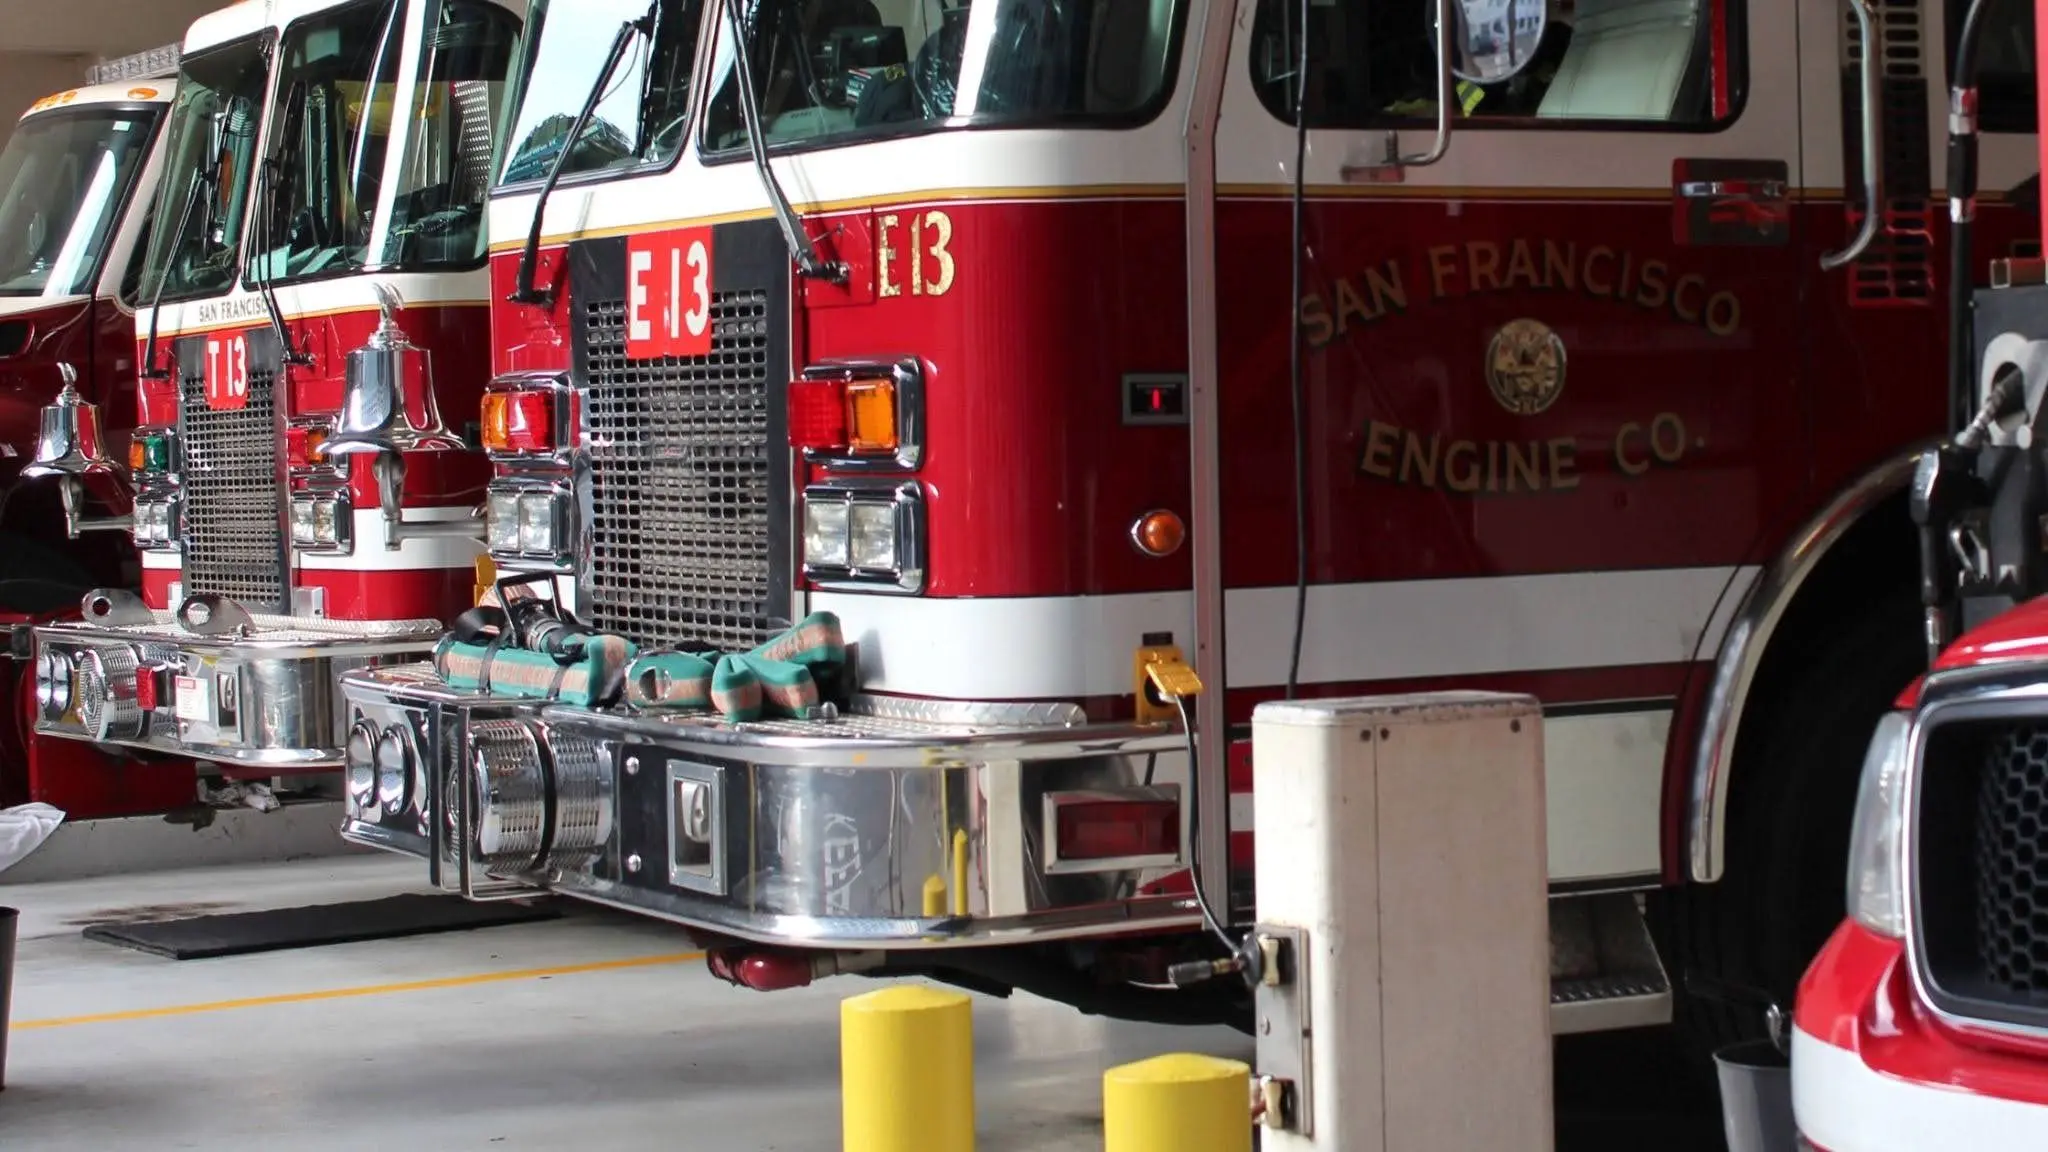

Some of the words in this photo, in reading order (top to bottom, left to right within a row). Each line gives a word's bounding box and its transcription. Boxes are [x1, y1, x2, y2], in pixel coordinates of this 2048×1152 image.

[199, 303, 217, 322] SAN
[221, 295, 269, 320] FRANCISC
[1299, 258, 1408, 347] SAN
[1427, 238, 1742, 337] FRANCISCO
[1360, 418, 1582, 494] ENGINE
[1614, 411, 1706, 476] CO.
